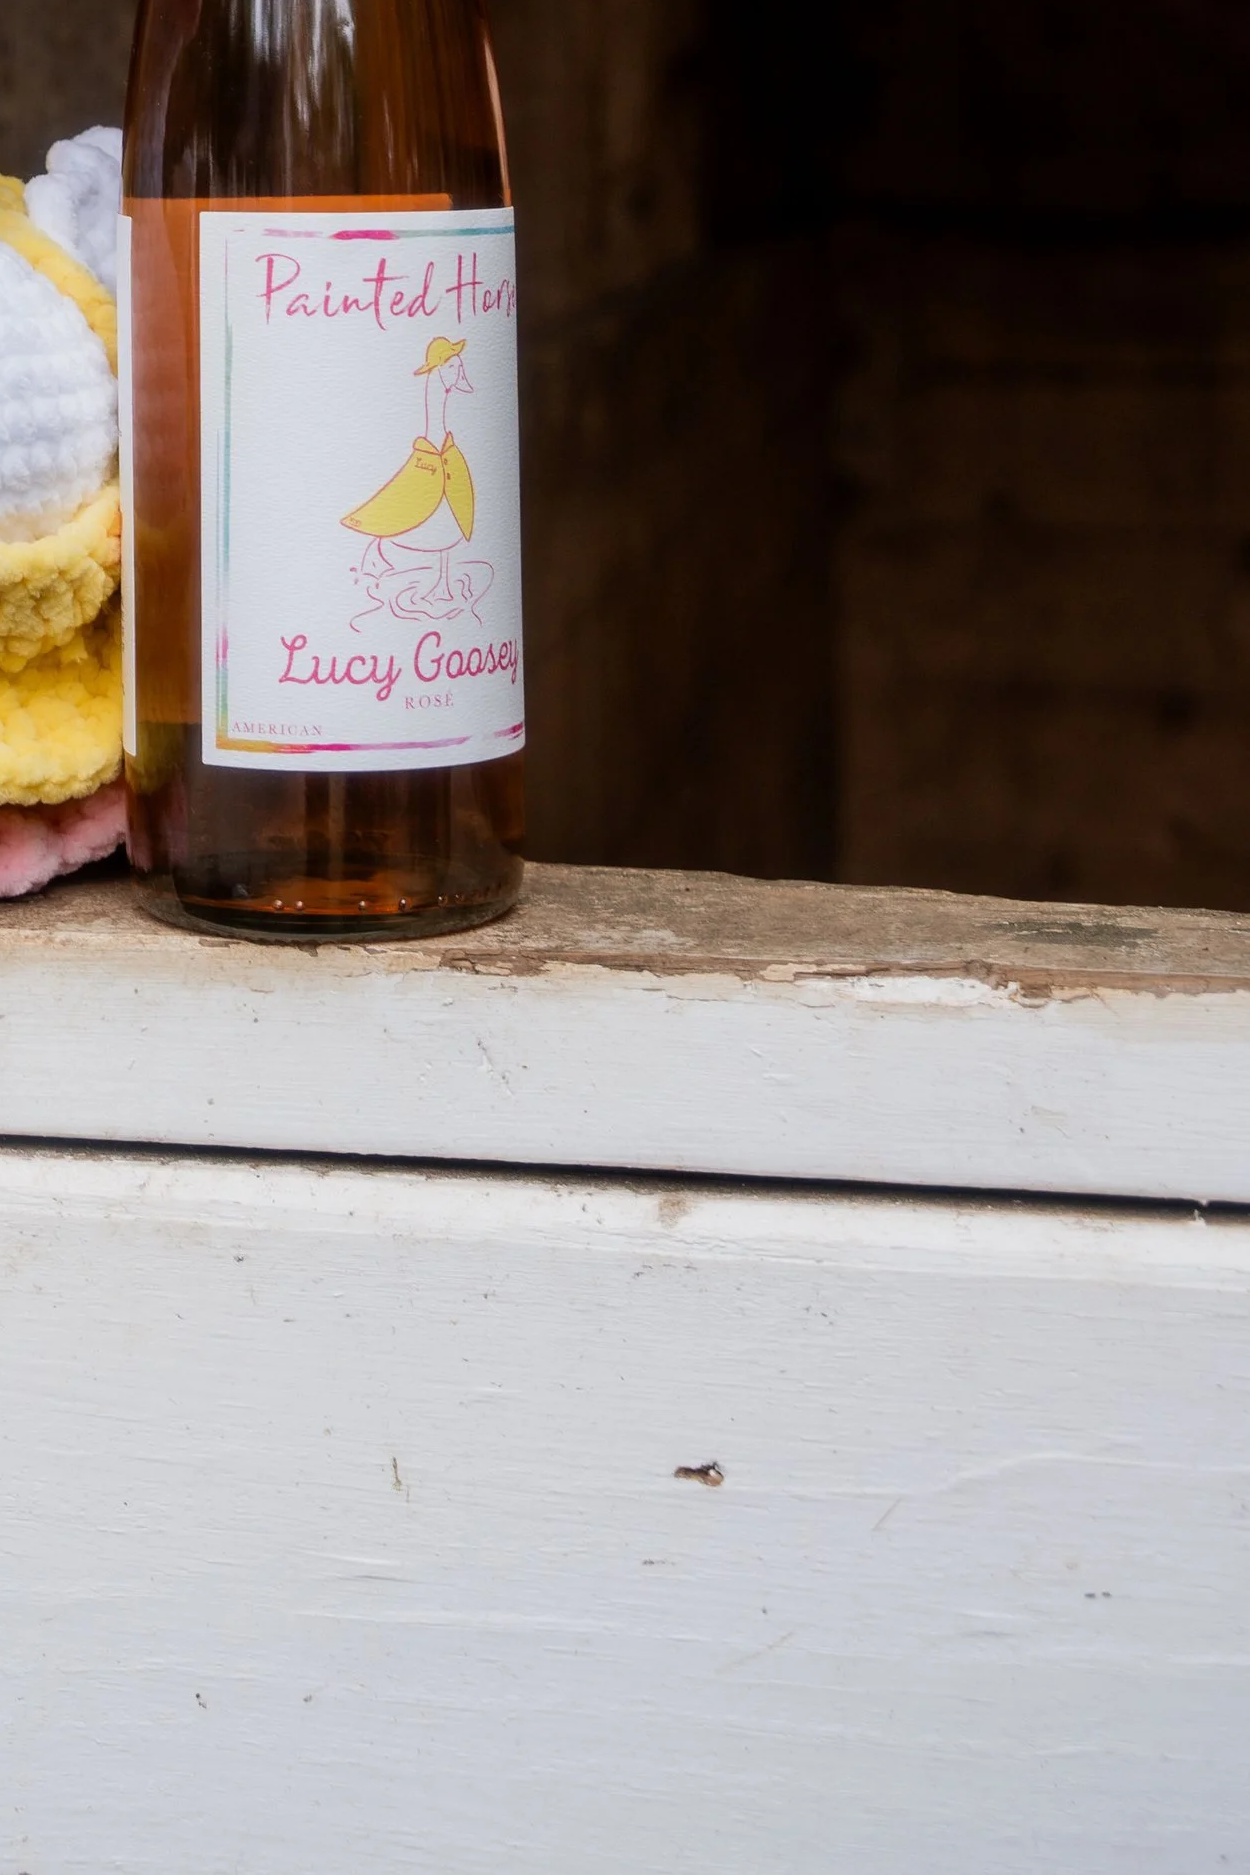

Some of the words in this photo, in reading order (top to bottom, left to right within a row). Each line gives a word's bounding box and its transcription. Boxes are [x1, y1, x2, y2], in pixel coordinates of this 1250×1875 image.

[255, 253, 439, 331] Painted
[279, 634, 401, 702] Lucy
[414, 631, 518, 685] Goosey
[231, 721, 323, 736] AMERICAN
